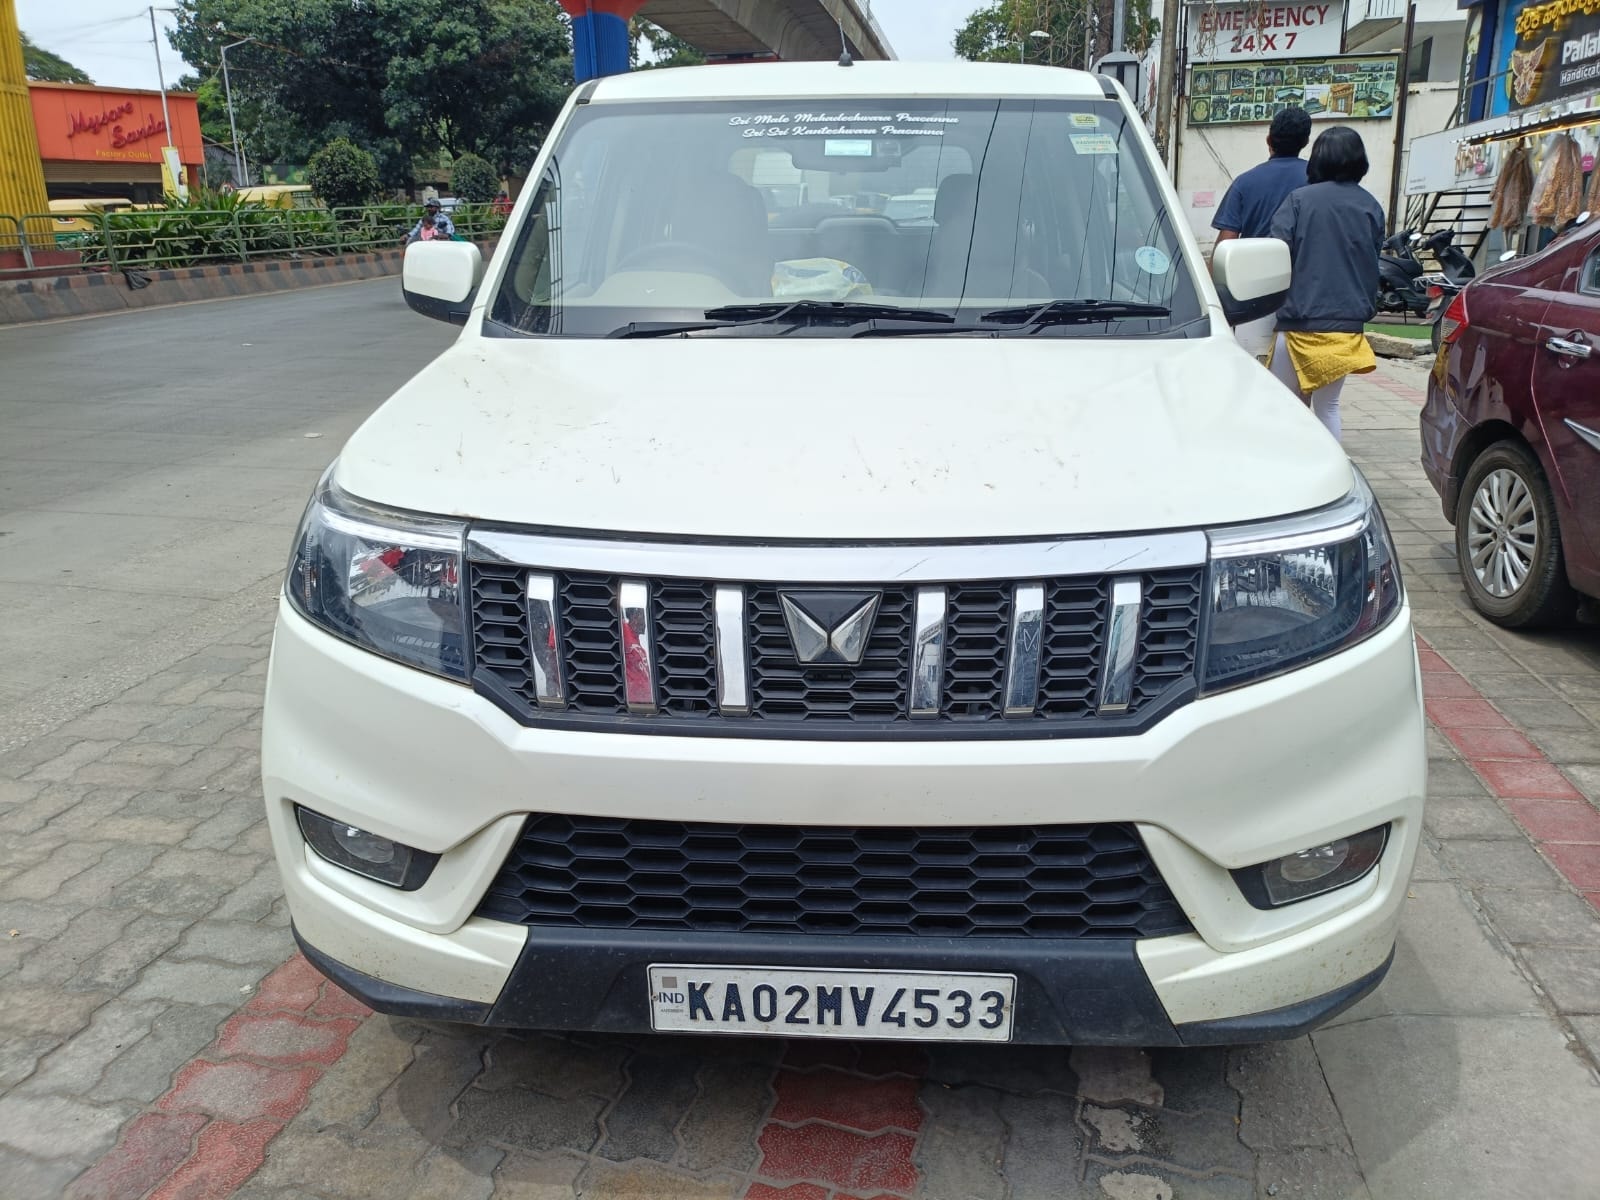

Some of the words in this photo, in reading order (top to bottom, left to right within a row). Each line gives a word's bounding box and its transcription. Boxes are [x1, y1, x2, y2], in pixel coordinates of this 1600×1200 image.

[1200, 4, 1330, 32] EMERGENCY
[1230, 35, 1256, 53] 24
[1262, 33, 1278, 51] X
[1284, 32, 1298, 50] 7
[67, 101, 134, 139] Mysore
[728, 116, 751, 126] Sri
[112, 113, 172, 149] Sanda
[742, 128, 764, 138] Sri
[766, 126, 790, 137] Sri
[95, 149, 126, 158] Factory
[127, 150, 152, 159] Outlet
[658, 991, 685, 1004] IND
[687, 981, 1006, 1029] KA02MV4533
